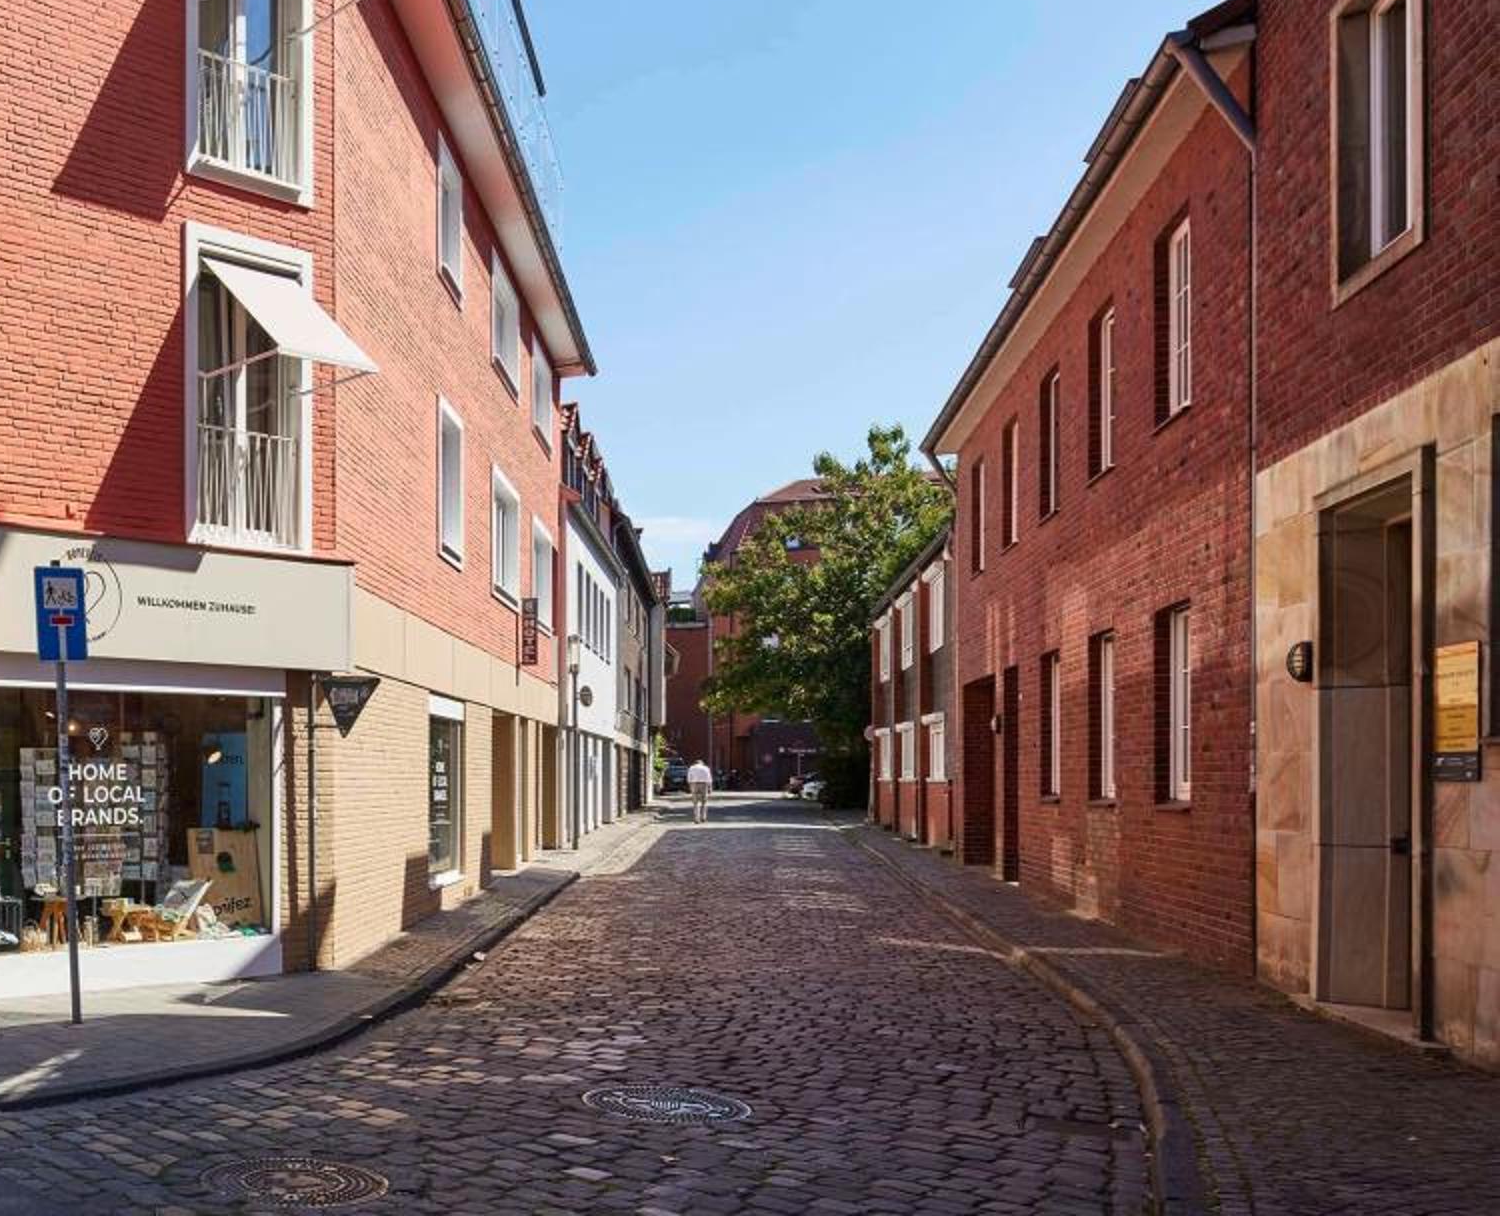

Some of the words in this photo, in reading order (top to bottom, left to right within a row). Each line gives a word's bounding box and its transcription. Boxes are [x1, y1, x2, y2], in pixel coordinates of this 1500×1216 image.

[137, 595, 207, 611] WILLKOMMEN
[68, 763, 128, 781] HOME
[83, 785, 146, 804] LOCAL
